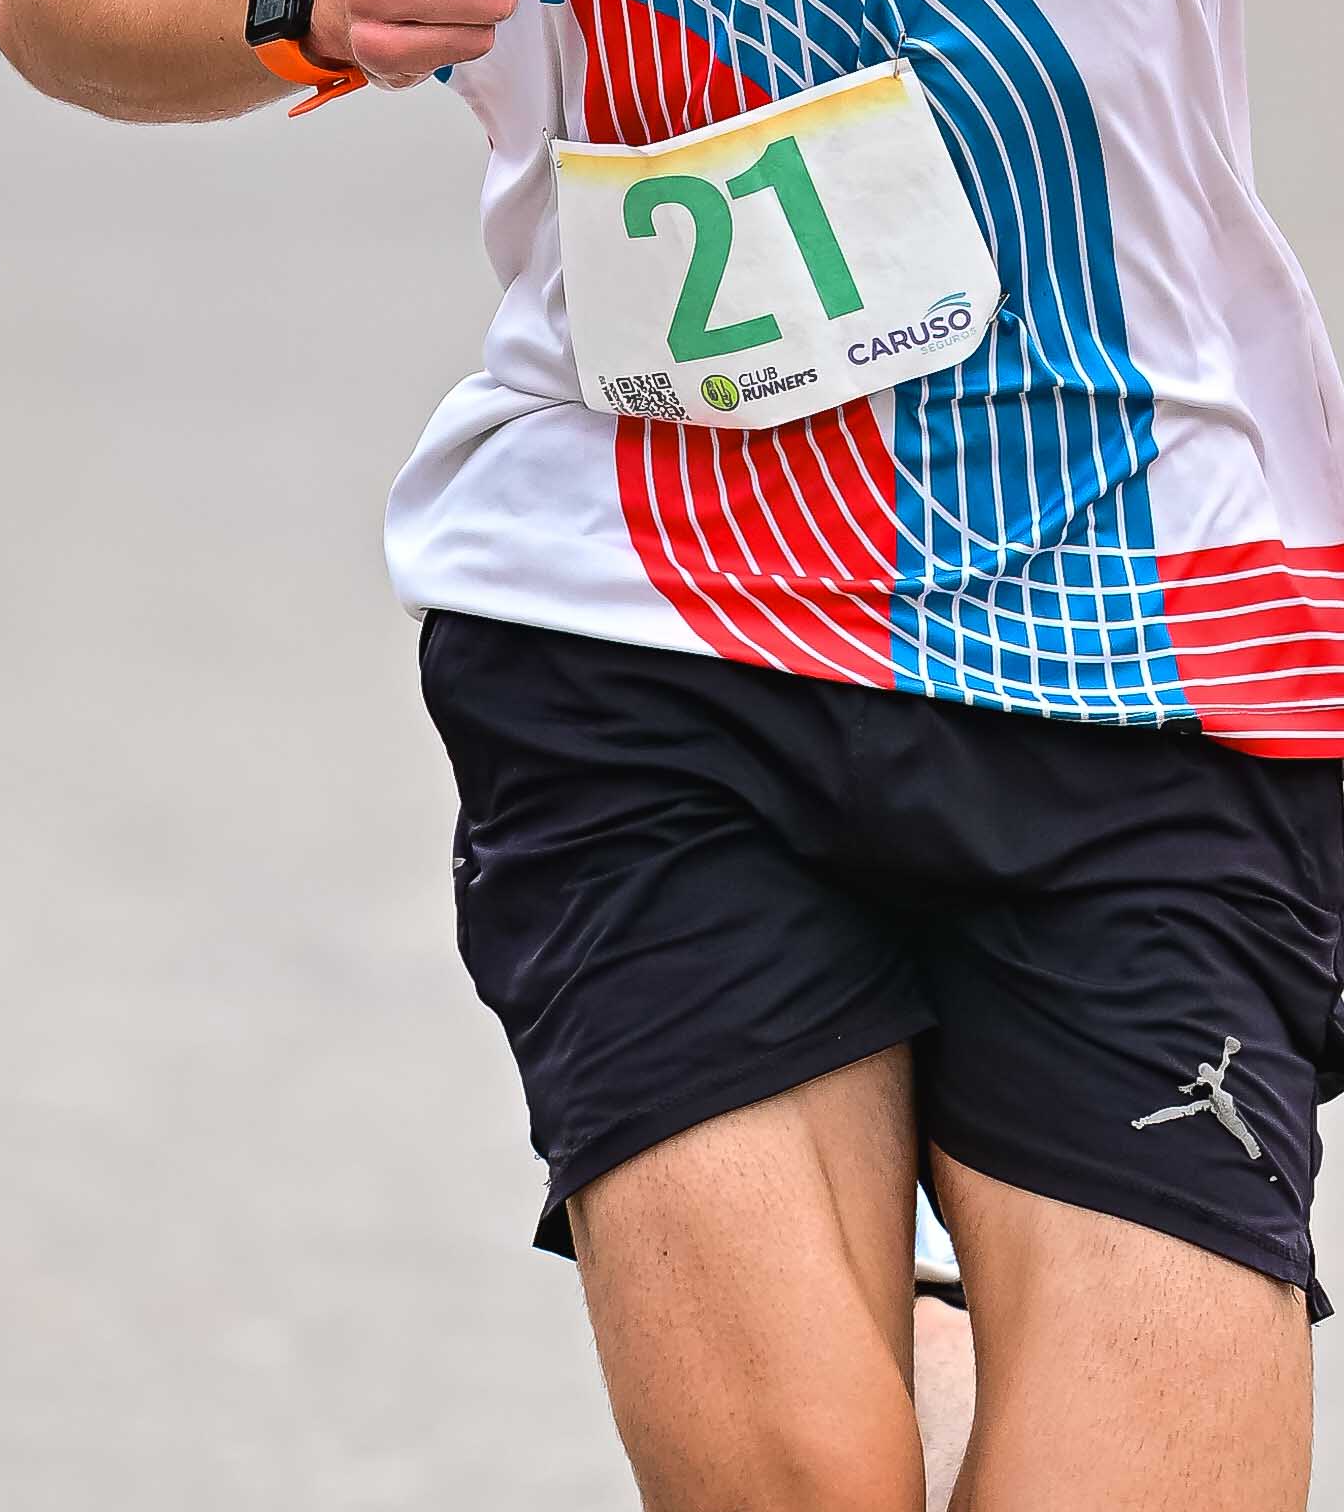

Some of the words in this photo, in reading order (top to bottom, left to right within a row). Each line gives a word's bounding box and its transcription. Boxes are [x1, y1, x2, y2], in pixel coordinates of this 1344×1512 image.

[624, 135, 864, 364] 21
[848, 309, 971, 365] CARUSO
[920, 328, 977, 355] SEGUROS
[738, 367, 777, 387] CLUB
[742, 369, 817, 402] RUNNER'S
